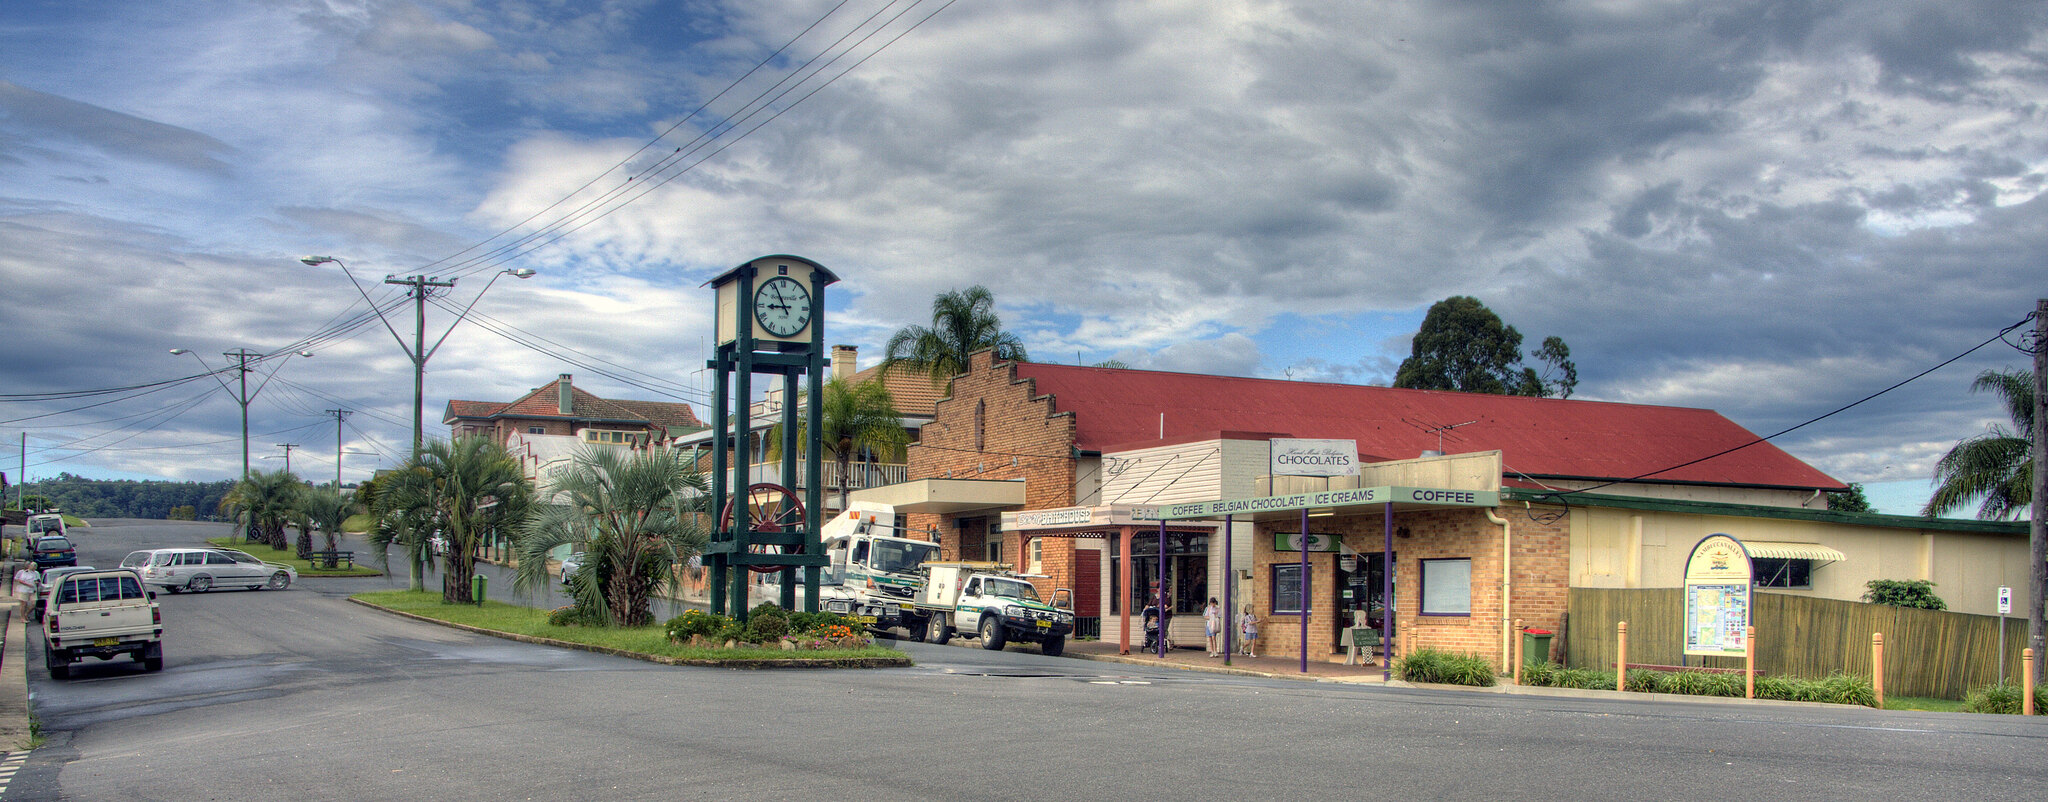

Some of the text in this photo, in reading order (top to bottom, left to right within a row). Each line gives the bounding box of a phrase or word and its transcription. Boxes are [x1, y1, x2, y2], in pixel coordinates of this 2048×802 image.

[1278, 454, 1350, 466] CHOCOLATES
[1172, 504, 1204, 516] COFFEE
[1212, 502, 1249, 513] BELGIAN
[1250, 495, 1305, 510] CHOCOLATE
[1314, 493, 1329, 505] ICE
[1331, 489, 1374, 504] CREAMS
[1412, 489, 1475, 504] COFFEE
[1041, 509, 1091, 526] BAKEHOUSE
